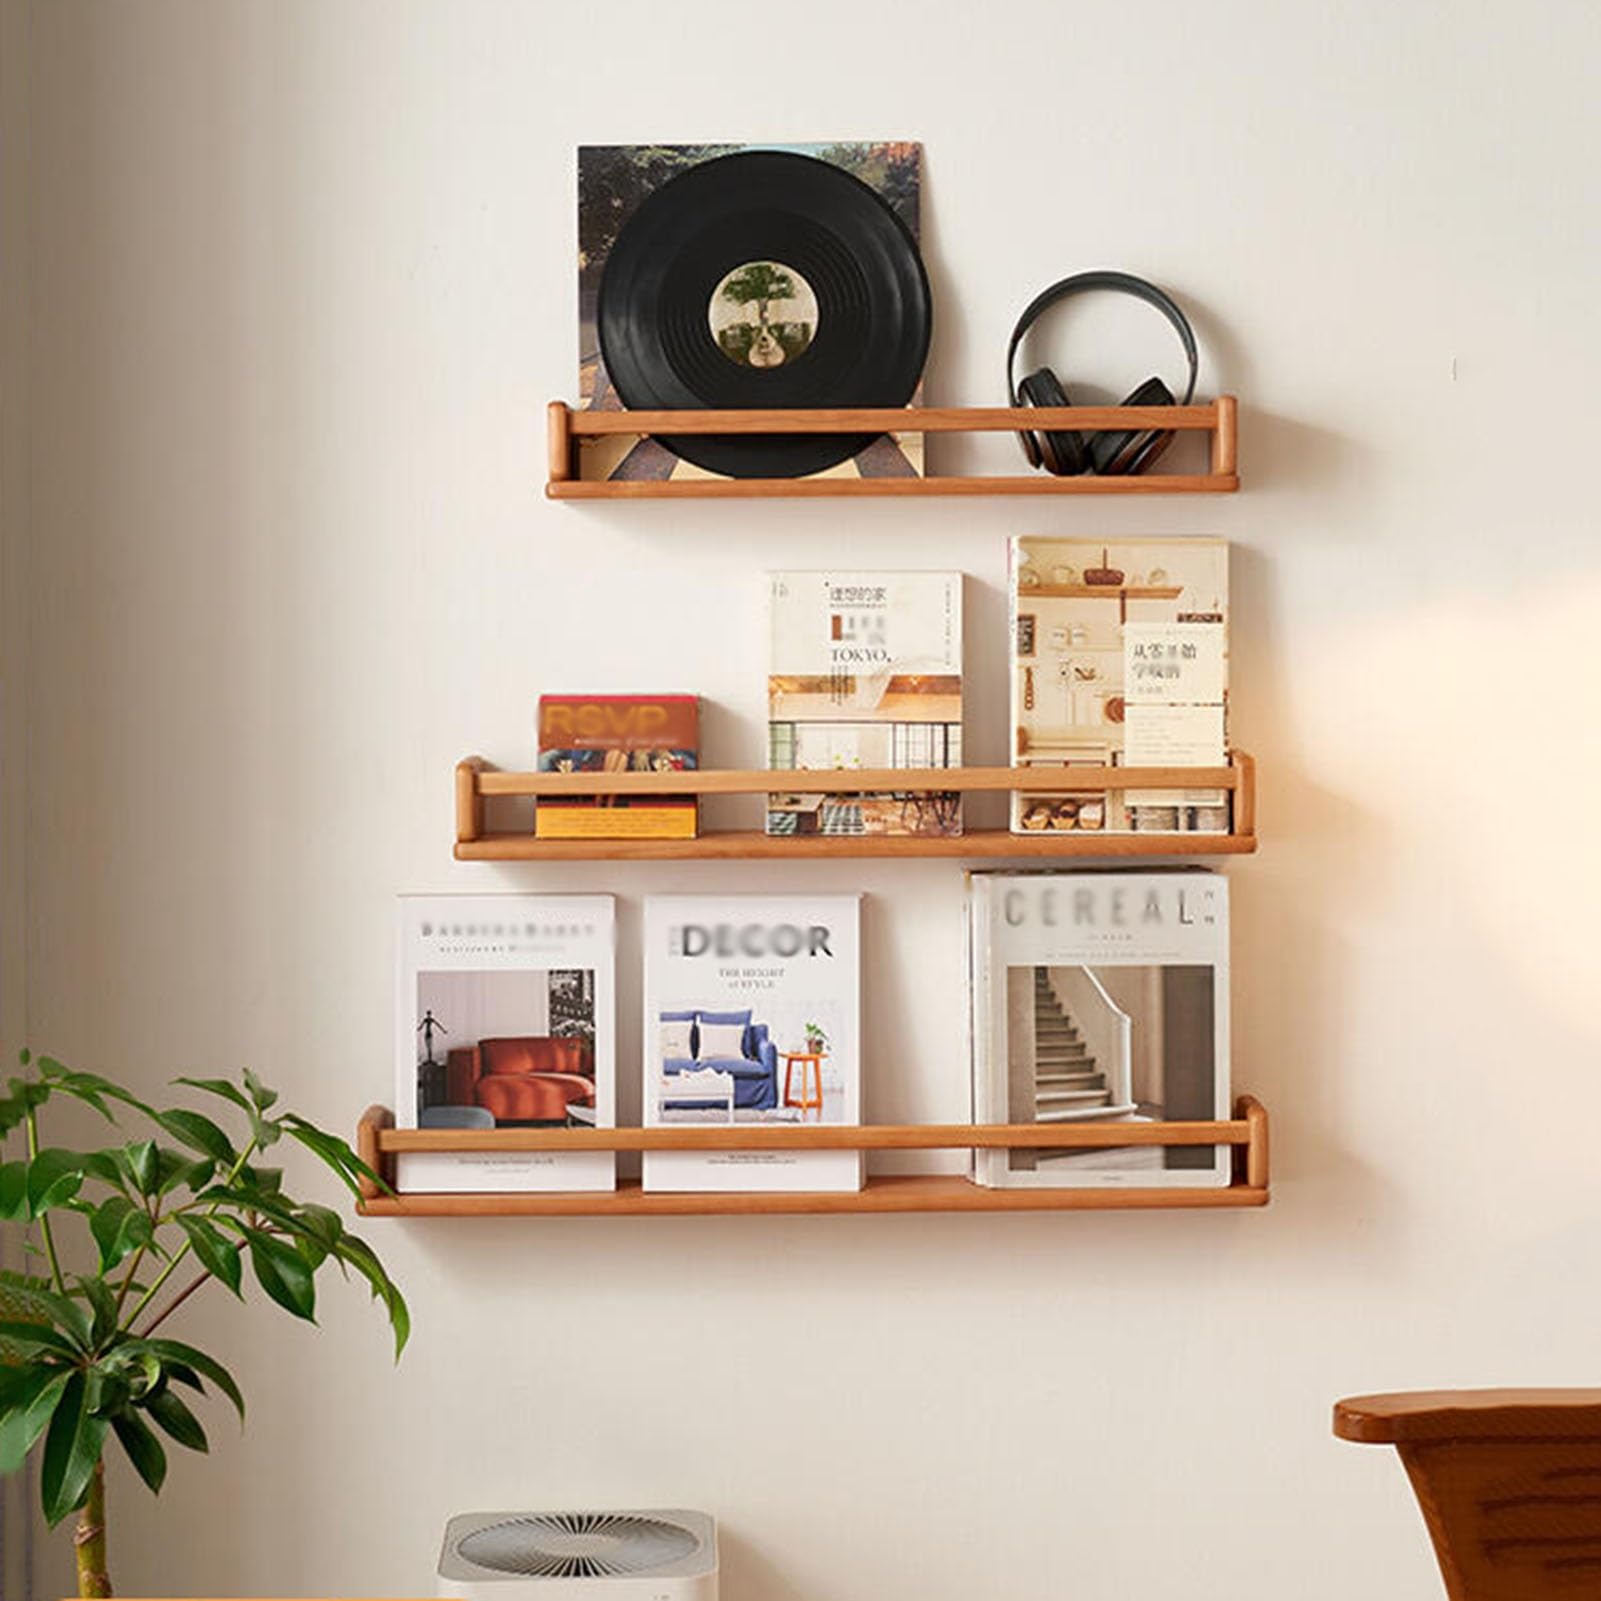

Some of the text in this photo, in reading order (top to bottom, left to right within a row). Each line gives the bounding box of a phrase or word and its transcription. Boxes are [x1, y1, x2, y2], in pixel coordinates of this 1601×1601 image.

[543, 703, 668, 735] RSVP
[1003, 887, 1194, 927] CEREAL
[682, 923, 833, 958] DECOR
